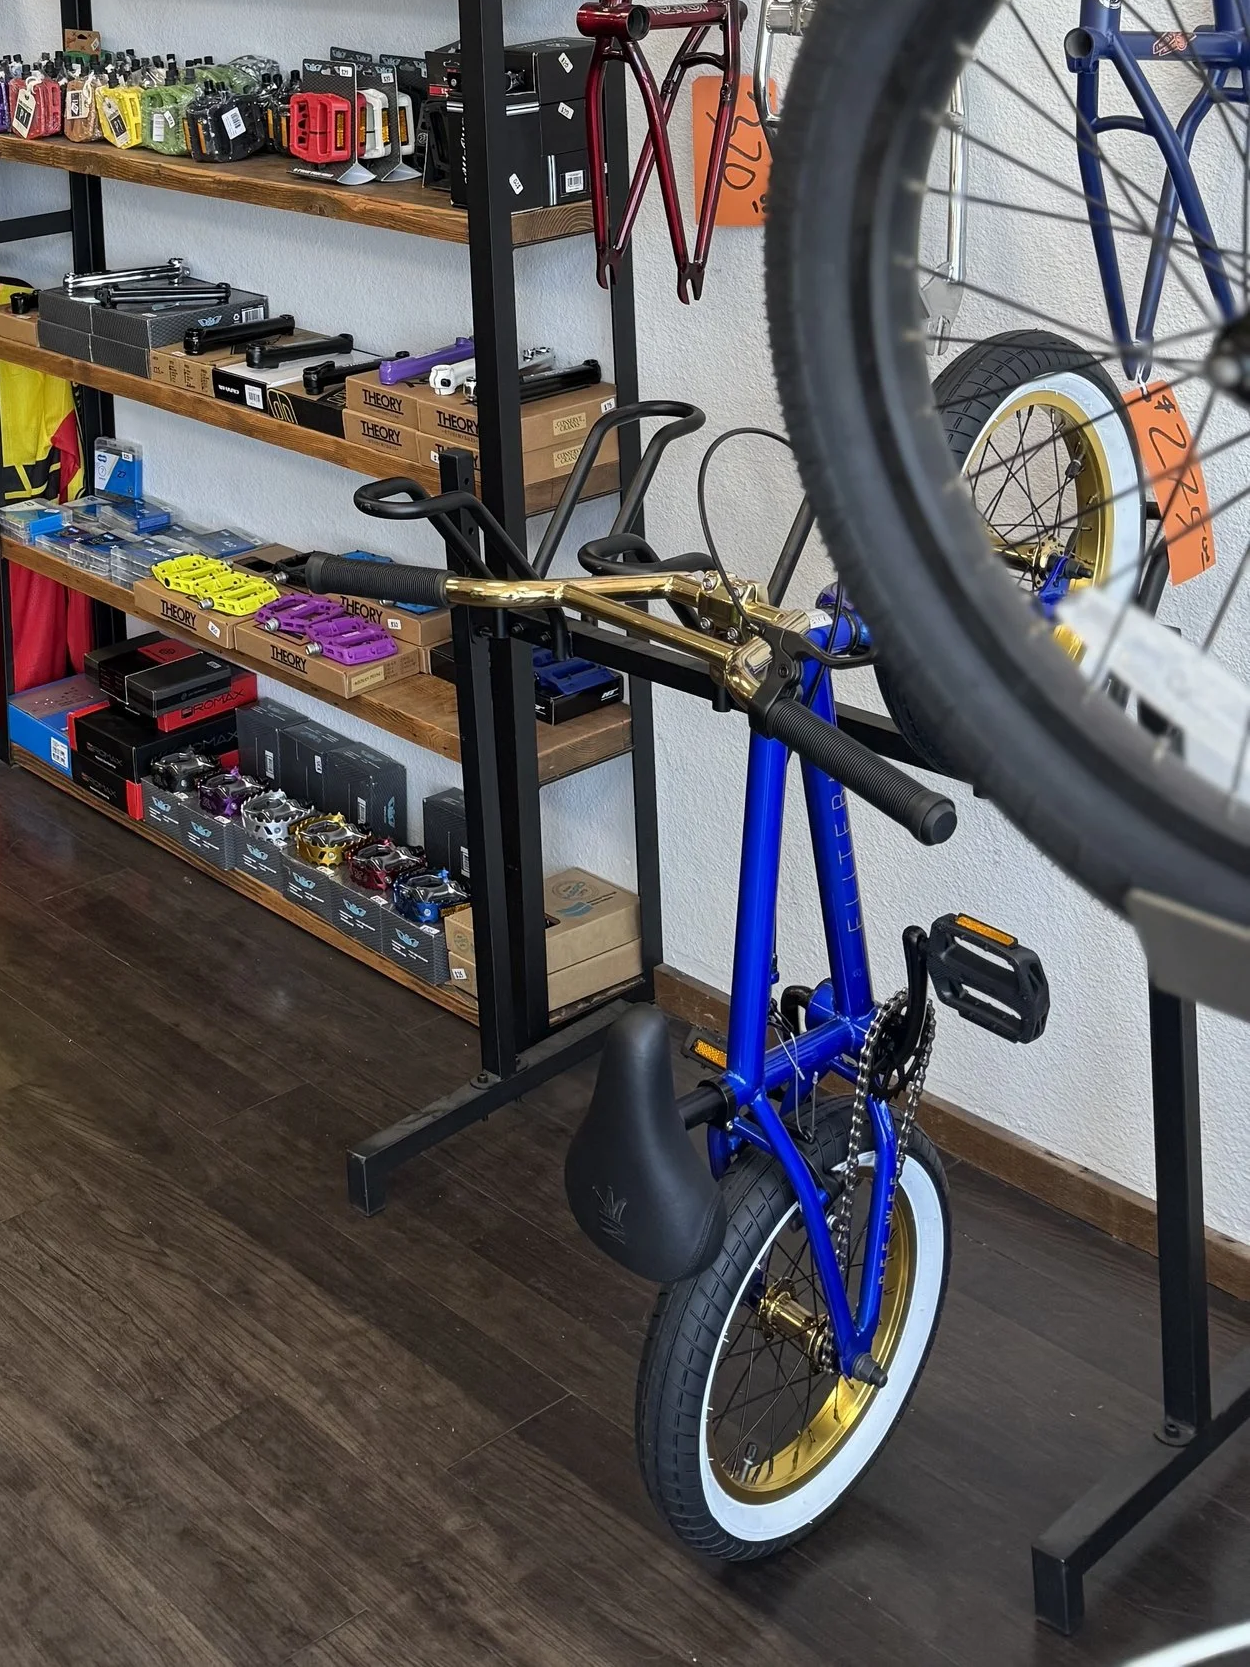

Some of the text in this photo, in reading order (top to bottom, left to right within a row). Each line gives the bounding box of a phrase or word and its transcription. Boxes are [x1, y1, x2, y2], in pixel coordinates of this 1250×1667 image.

[361, 388, 404, 412] THEORY
[360, 420, 402, 444] THEORY
[435, 410, 479, 434] THEORY
[160, 598, 197, 628] THEORY
[340, 597, 384, 625] THEORY
[270, 645, 308, 672] THEORY
[180, 688, 246, 718] PROMAX
